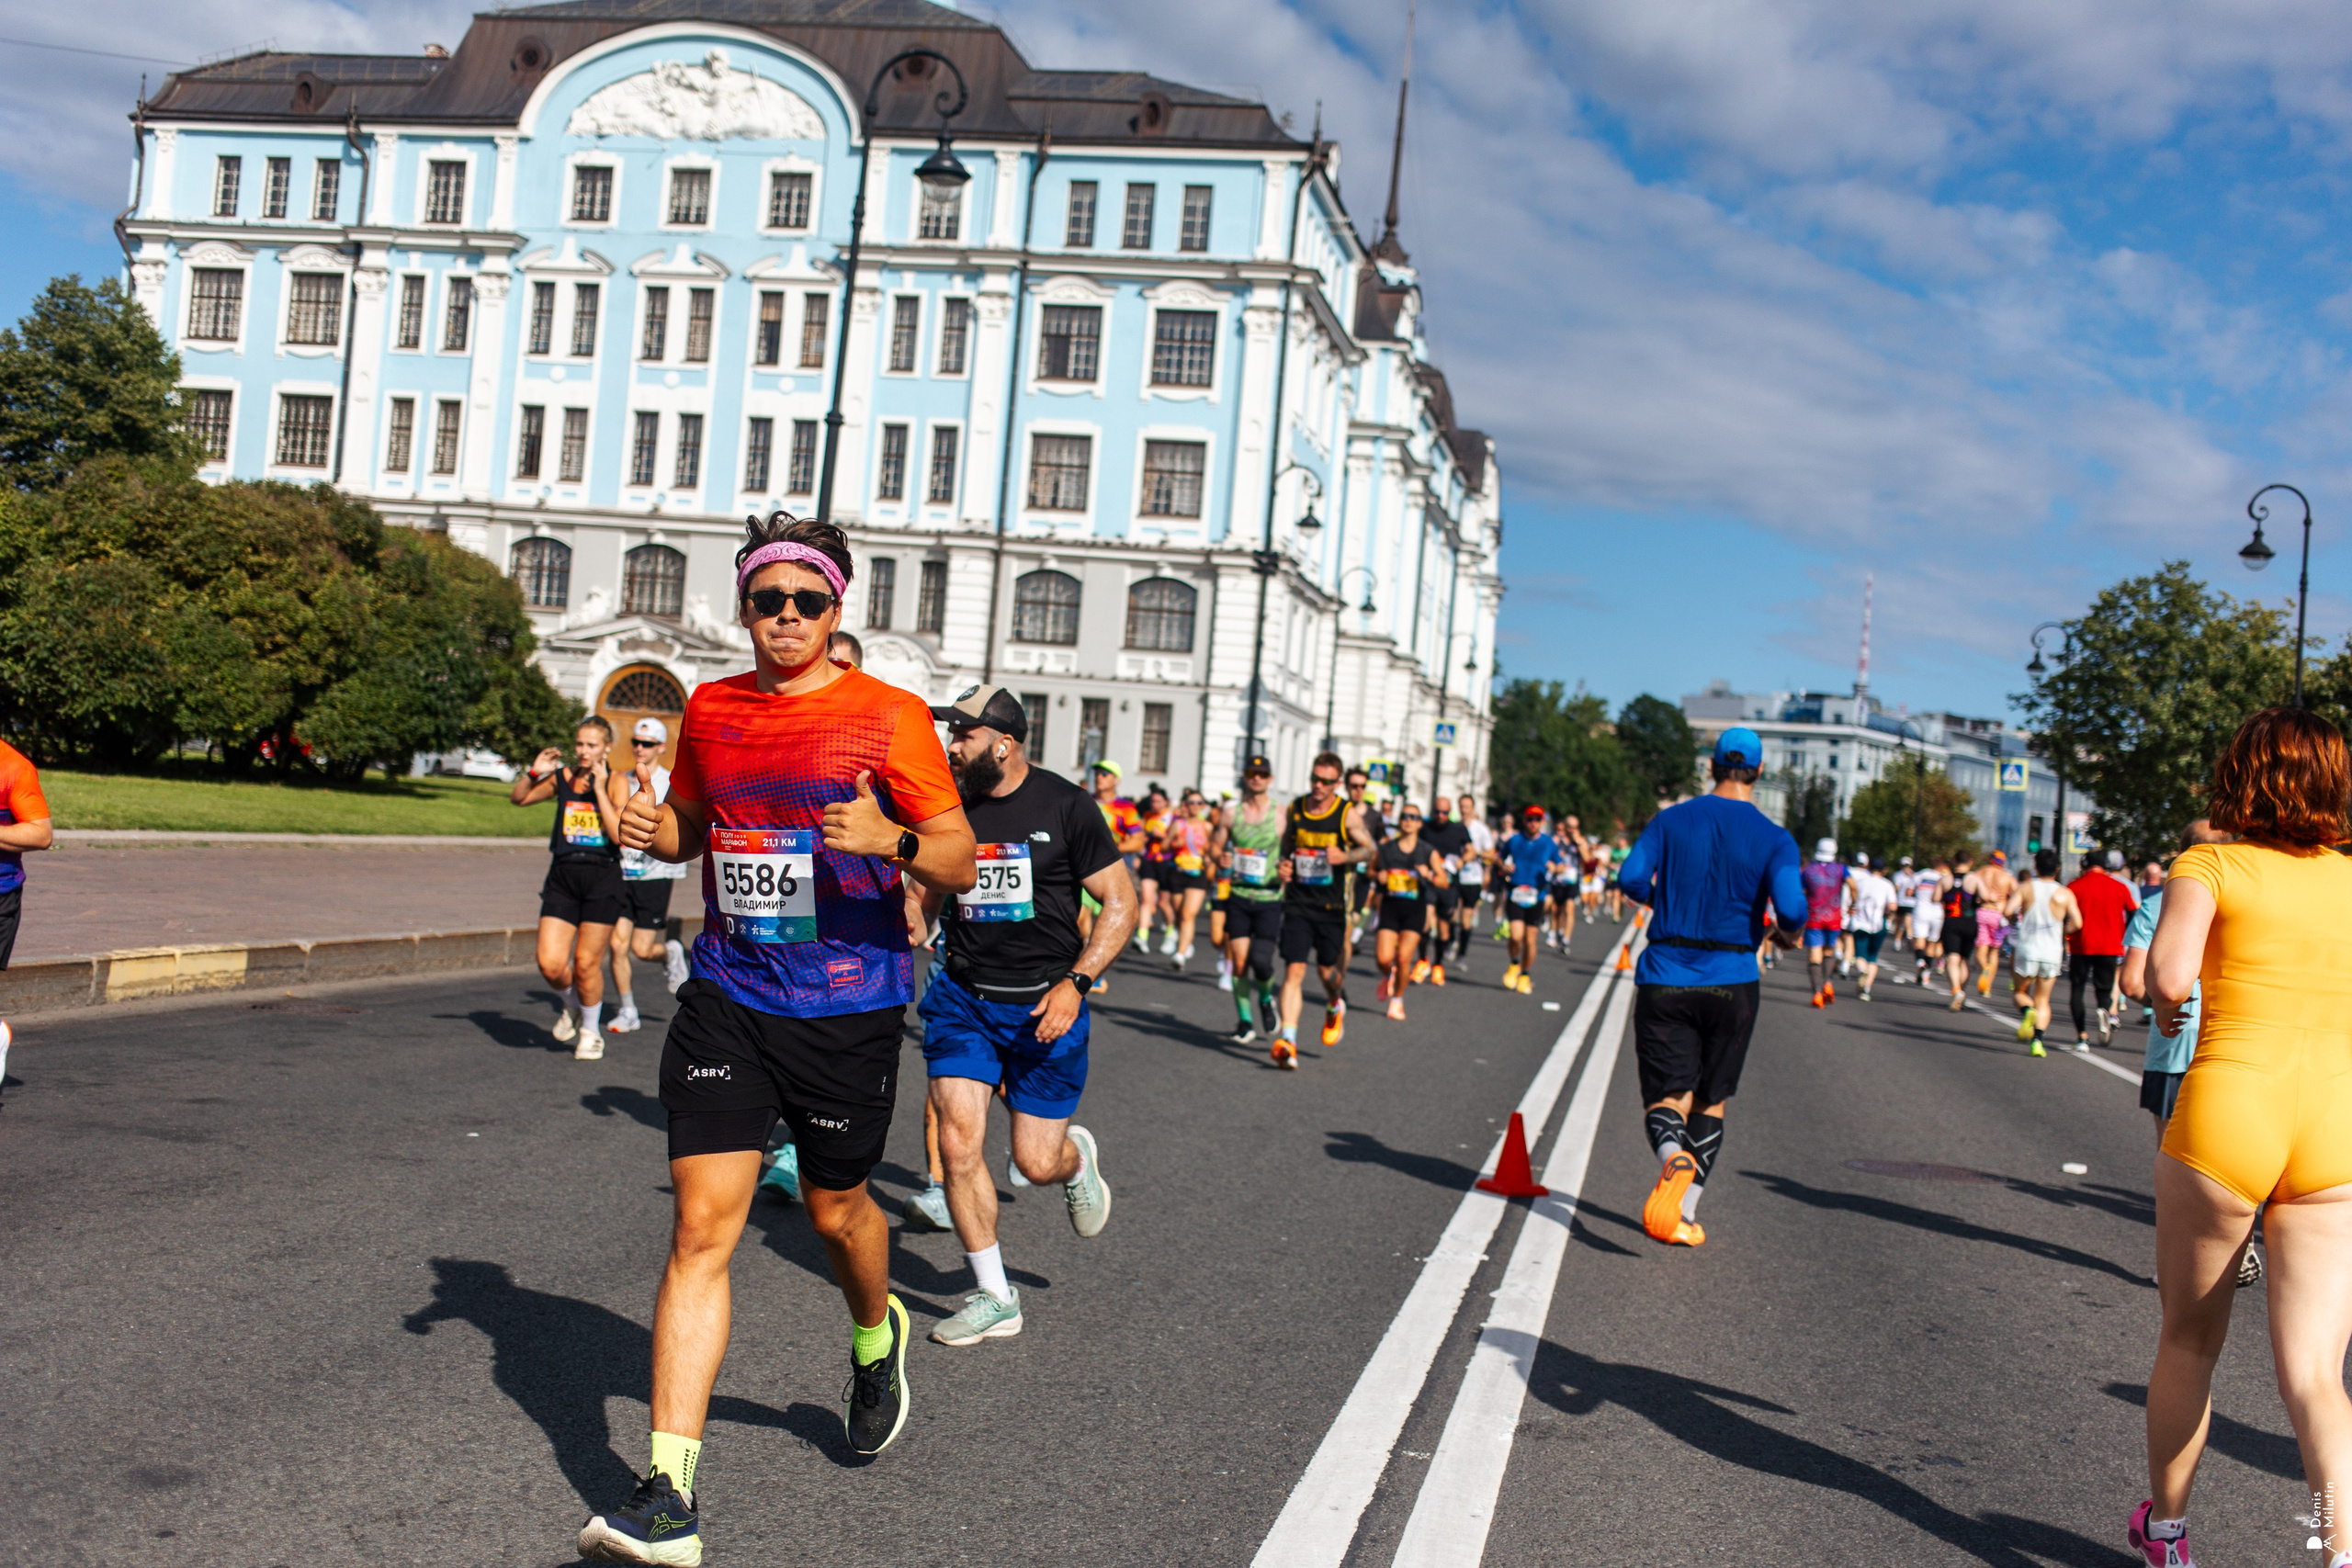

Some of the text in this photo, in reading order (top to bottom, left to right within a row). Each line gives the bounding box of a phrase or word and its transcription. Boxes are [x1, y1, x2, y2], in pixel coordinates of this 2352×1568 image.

[763, 839, 779, 847] 21,1
[722, 862, 797, 897] 5586
[970, 866, 1021, 889] 575
[980, 891, 1006, 900] ДЕНИС
[734, 898, 786, 911] ВЛАДИМИР
[964, 906, 973, 919] D
[726, 917, 735, 934] D
[692, 1068, 726, 1077] ASRV
[810, 1116, 844, 1131] ASRV
